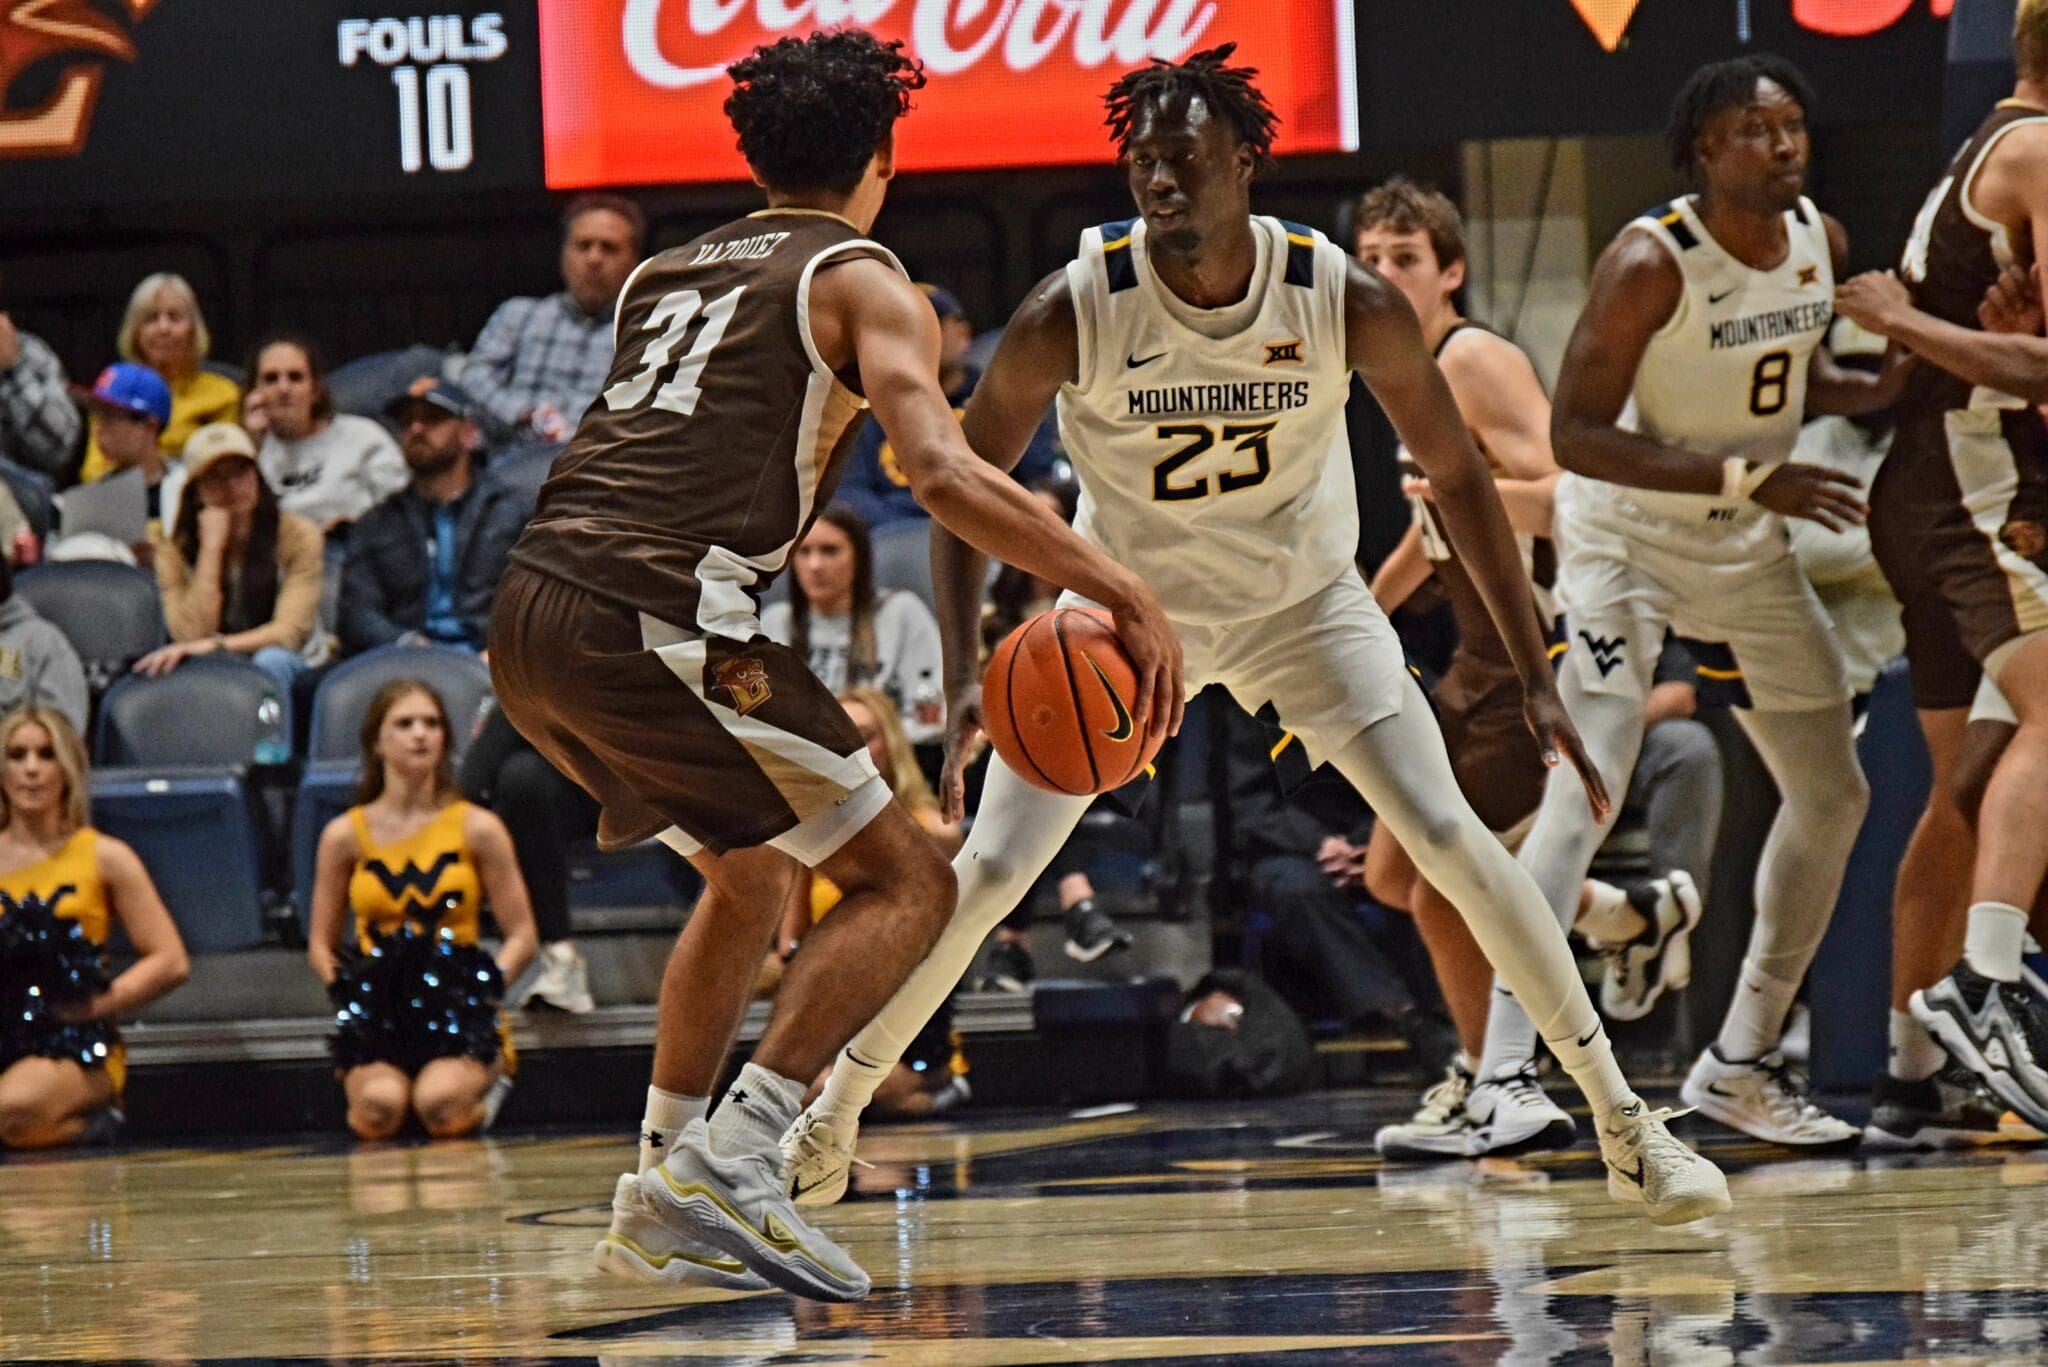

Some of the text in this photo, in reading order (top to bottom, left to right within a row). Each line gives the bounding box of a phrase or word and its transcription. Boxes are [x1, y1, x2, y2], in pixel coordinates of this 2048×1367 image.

[338, 13, 508, 67] FOULS
[391, 64, 473, 173] 10
[603, 284, 748, 416] 31
[1710, 300, 1831, 350] MOUNTAINEERS
[1128, 380, 1310, 415] MOUNTAINEERS
[1749, 348, 1793, 417] 8
[1153, 419, 1281, 503] 23
